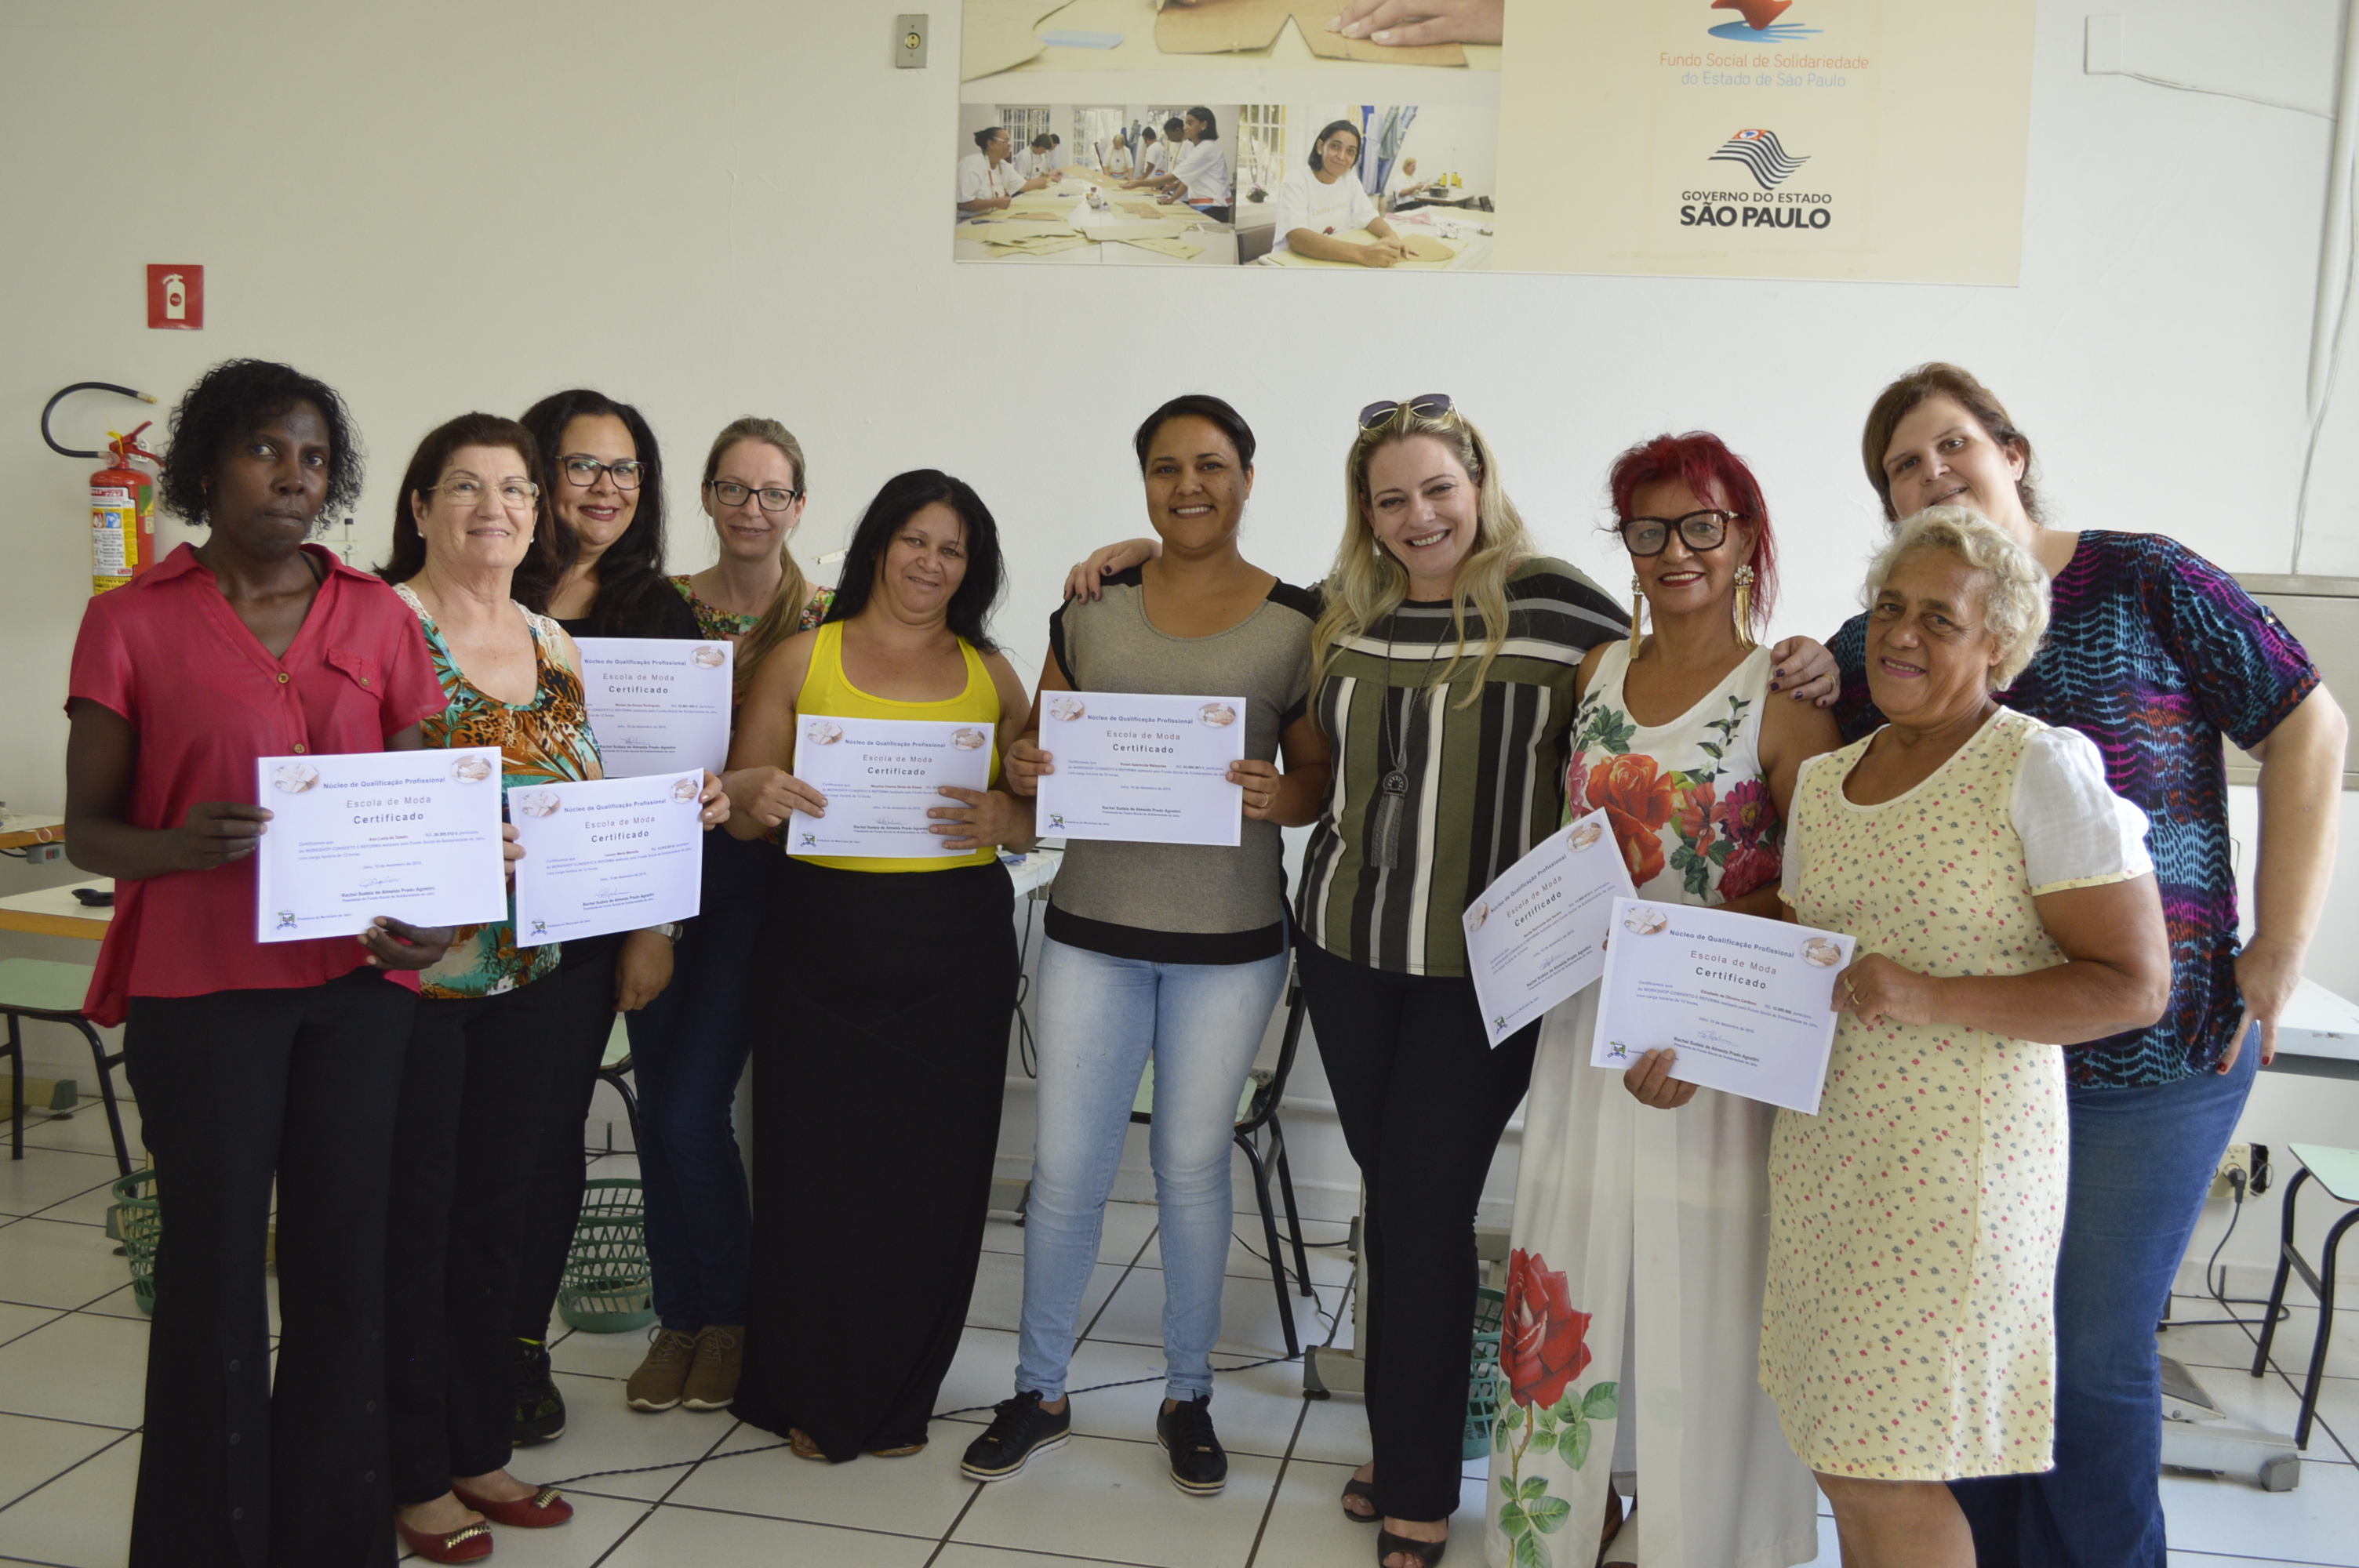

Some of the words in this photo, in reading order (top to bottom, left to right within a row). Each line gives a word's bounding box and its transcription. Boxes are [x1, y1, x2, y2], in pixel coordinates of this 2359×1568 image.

[1659, 52, 1702, 67] Fundo
[1706, 53, 1747, 67] Social
[1753, 54, 1770, 67] de
[1773, 53, 1869, 69] Solidariedade
[1681, 71, 1699, 85] do
[1703, 71, 1750, 85] Estado
[1756, 72, 1773, 86] de
[1777, 72, 1803, 86] São
[1807, 73, 1846, 87] Paulo
[1681, 191, 1750, 202] GOVERNO
[1753, 192, 1774, 203] DO
[1778, 193, 1833, 204] ESTADO
[1680, 201, 1738, 227] SÃO
[1742, 206, 1832, 229] PAULO
[609, 685, 668, 694] Certificado
[1107, 730, 1137, 739] Escola
[1112, 743, 1174, 753] Certificado
[867, 767, 925, 775] Certificado
[346, 799, 382, 808] Escola
[387, 797, 399, 806] de
[404, 796, 431, 804] Moda
[596, 802, 633, 811] Qualificação
[633, 798, 667, 807] Profissional
[353, 811, 423, 825] Certificado
[584, 820, 615, 829] Escola
[633, 815, 655, 824] Moda
[591, 829, 649, 843] Certificado
[1490, 900, 1504, 913] Núcleo
[1510, 874, 1537, 897] Qualificação
[1537, 853, 1567, 877] Profissional
[1506, 898, 1529, 918] Escola
[1531, 891, 1540, 900] de
[1541, 876, 1562, 892] Moda
[1514, 891, 1561, 927] Certificado
[1669, 929, 1695, 938] Núcleo
[1707, 935, 1752, 949] Qualificação
[1754, 944, 1794, 958] Profissional
[1690, 949, 1727, 964] Escola
[1732, 958, 1745, 967] de
[1750, 961, 1776, 975] Moda
[1696, 967, 1766, 989] Certificado
